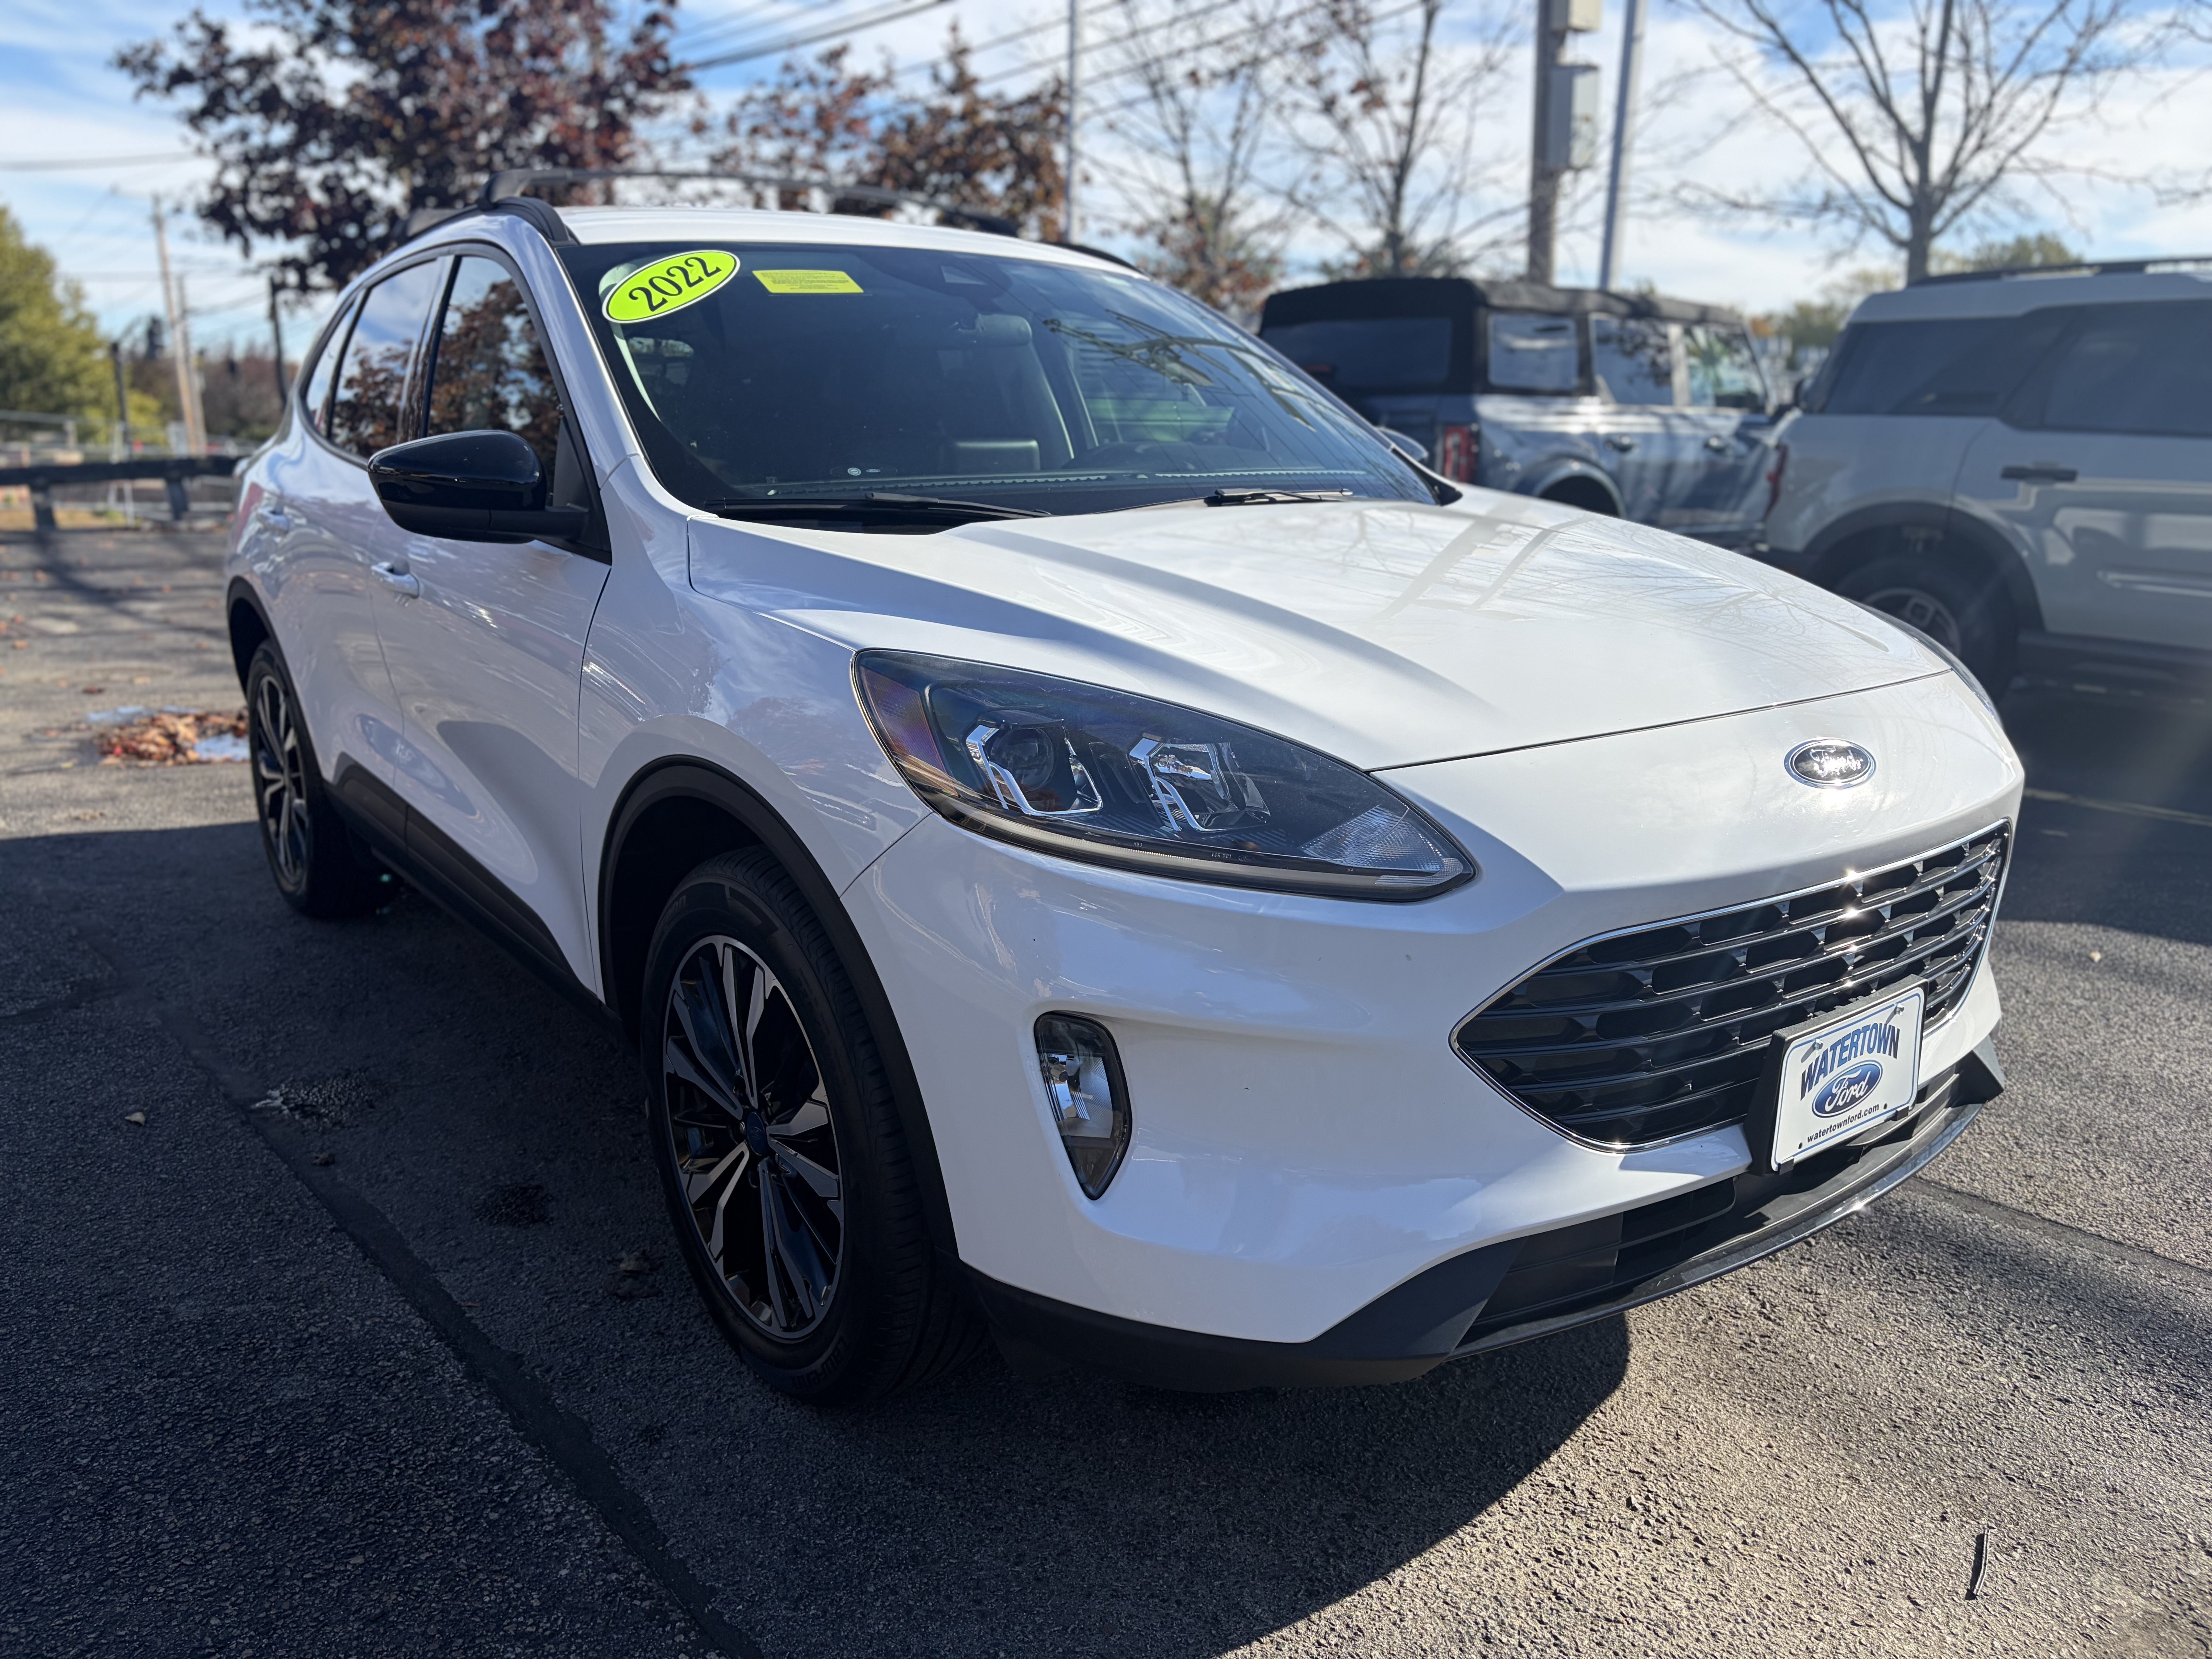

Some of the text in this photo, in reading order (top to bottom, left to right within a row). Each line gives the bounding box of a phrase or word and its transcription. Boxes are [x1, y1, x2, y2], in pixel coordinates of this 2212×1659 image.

[629, 256, 722, 312] 2022
[1809, 746, 1863, 778] Ford
[1801, 1023, 1900, 1101] WATERTOWN
[1825, 1069, 1872, 1112] Ford
[1807, 1104, 1879, 1143] watertownford.com
